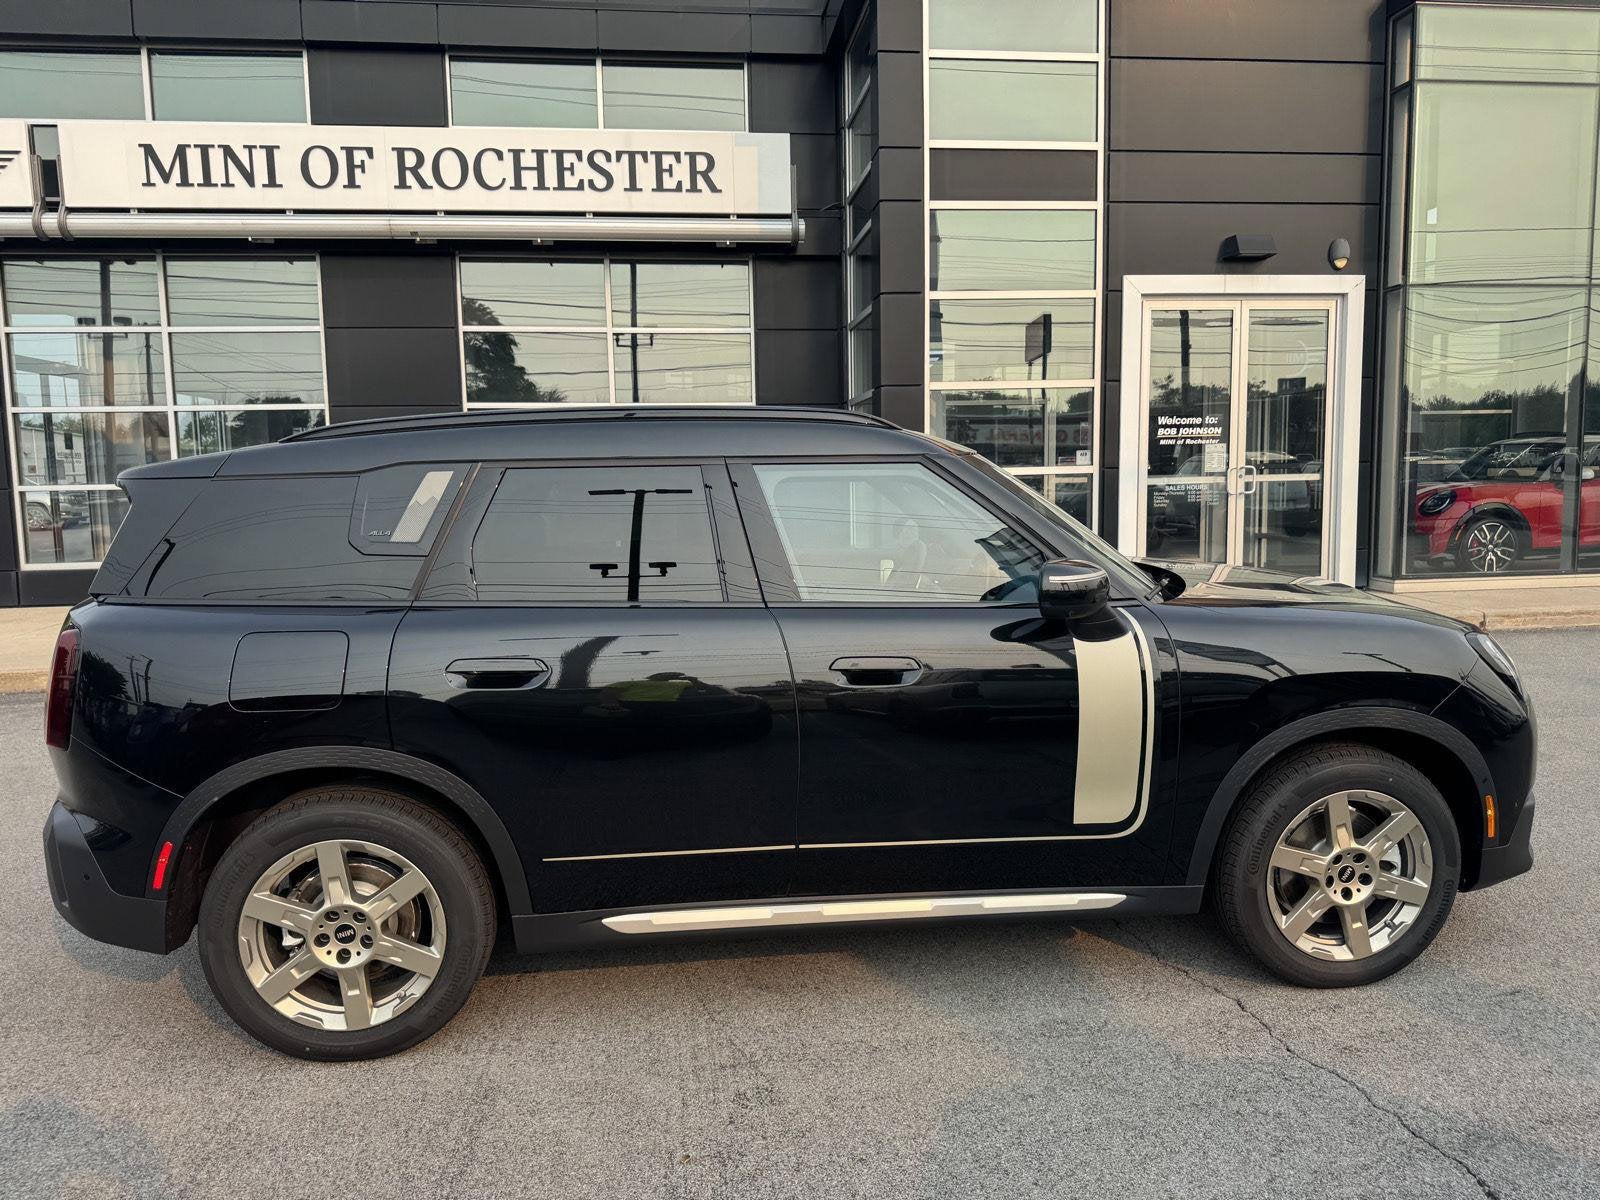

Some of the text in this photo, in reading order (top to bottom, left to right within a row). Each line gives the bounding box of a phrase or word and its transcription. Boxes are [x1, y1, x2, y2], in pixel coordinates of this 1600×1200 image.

[138, 143, 722, 193] MINI OF ROCHESTER
[1158, 416, 1218, 425] Welcome to:
[1157, 427, 1222, 436] BOB JOHNSON
[1340, 866, 1353, 882] MINI
[336, 928, 355, 939] MINI
